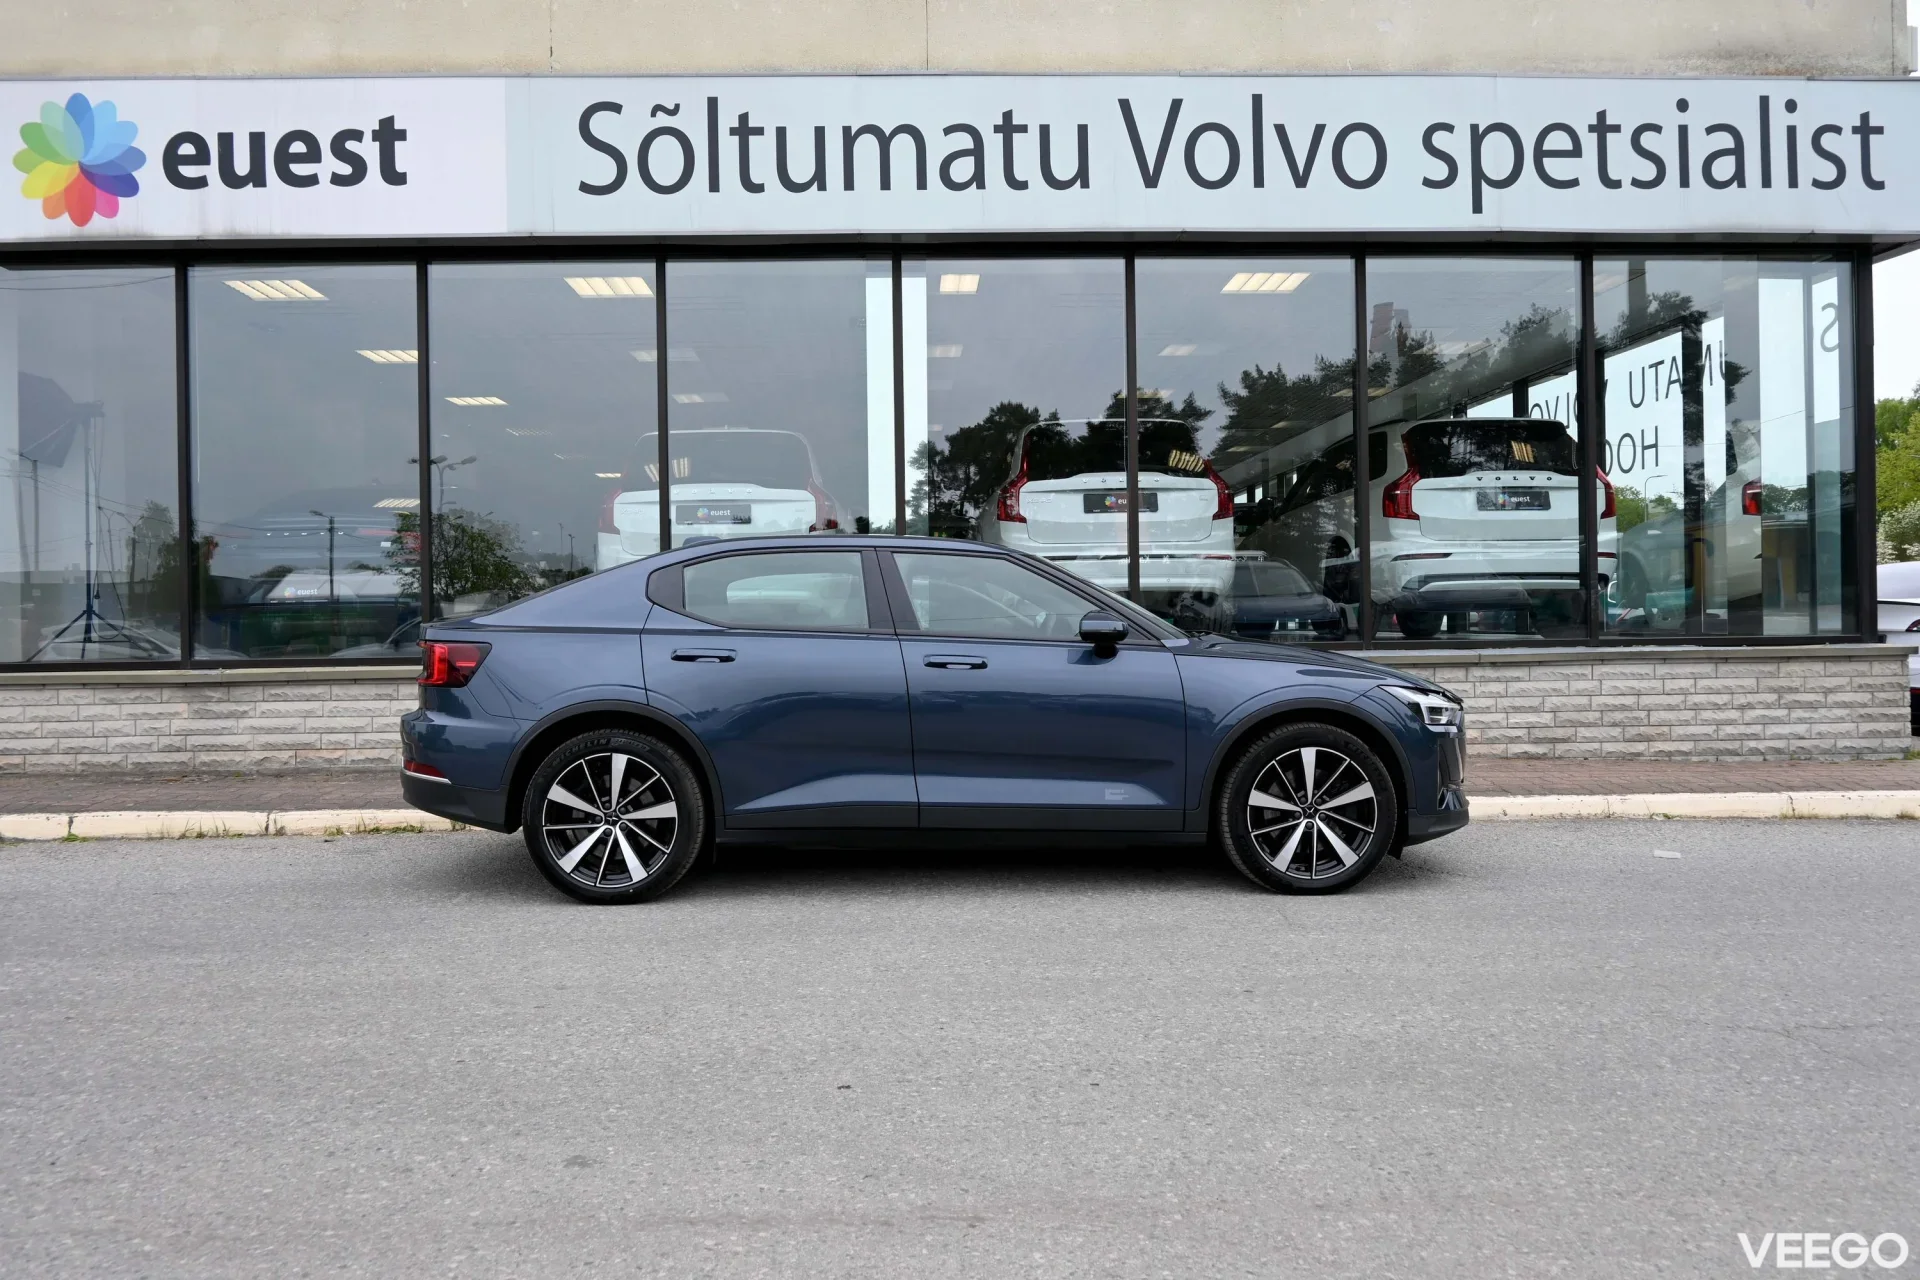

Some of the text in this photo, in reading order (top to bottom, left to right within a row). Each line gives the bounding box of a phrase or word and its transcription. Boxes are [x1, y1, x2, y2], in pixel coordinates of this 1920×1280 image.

[162, 115, 408, 190] euest
[578, 93, 1886, 215] Sõltumatu Volvo spetsialist
[552, 737, 608, 767] MICHELIN
